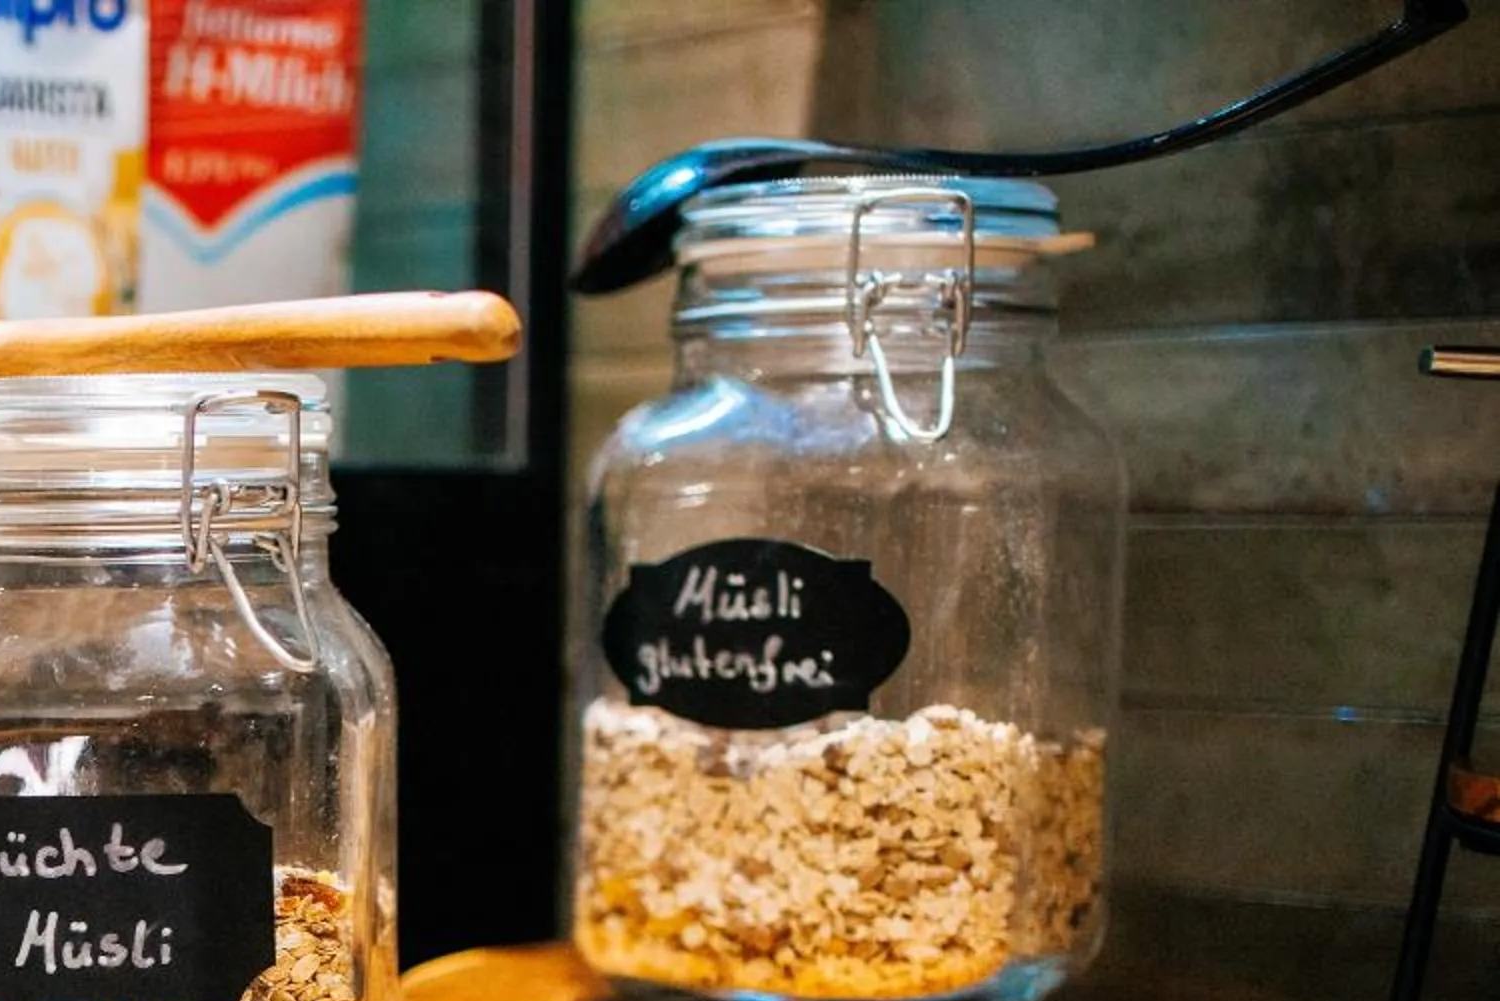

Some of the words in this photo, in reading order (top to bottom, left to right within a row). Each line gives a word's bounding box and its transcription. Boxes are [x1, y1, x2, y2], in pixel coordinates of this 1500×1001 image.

[674, 565, 803, 624] Müsli
[637, 634, 835, 695] glutenfrei
[14, 909, 173, 975] Müsli
